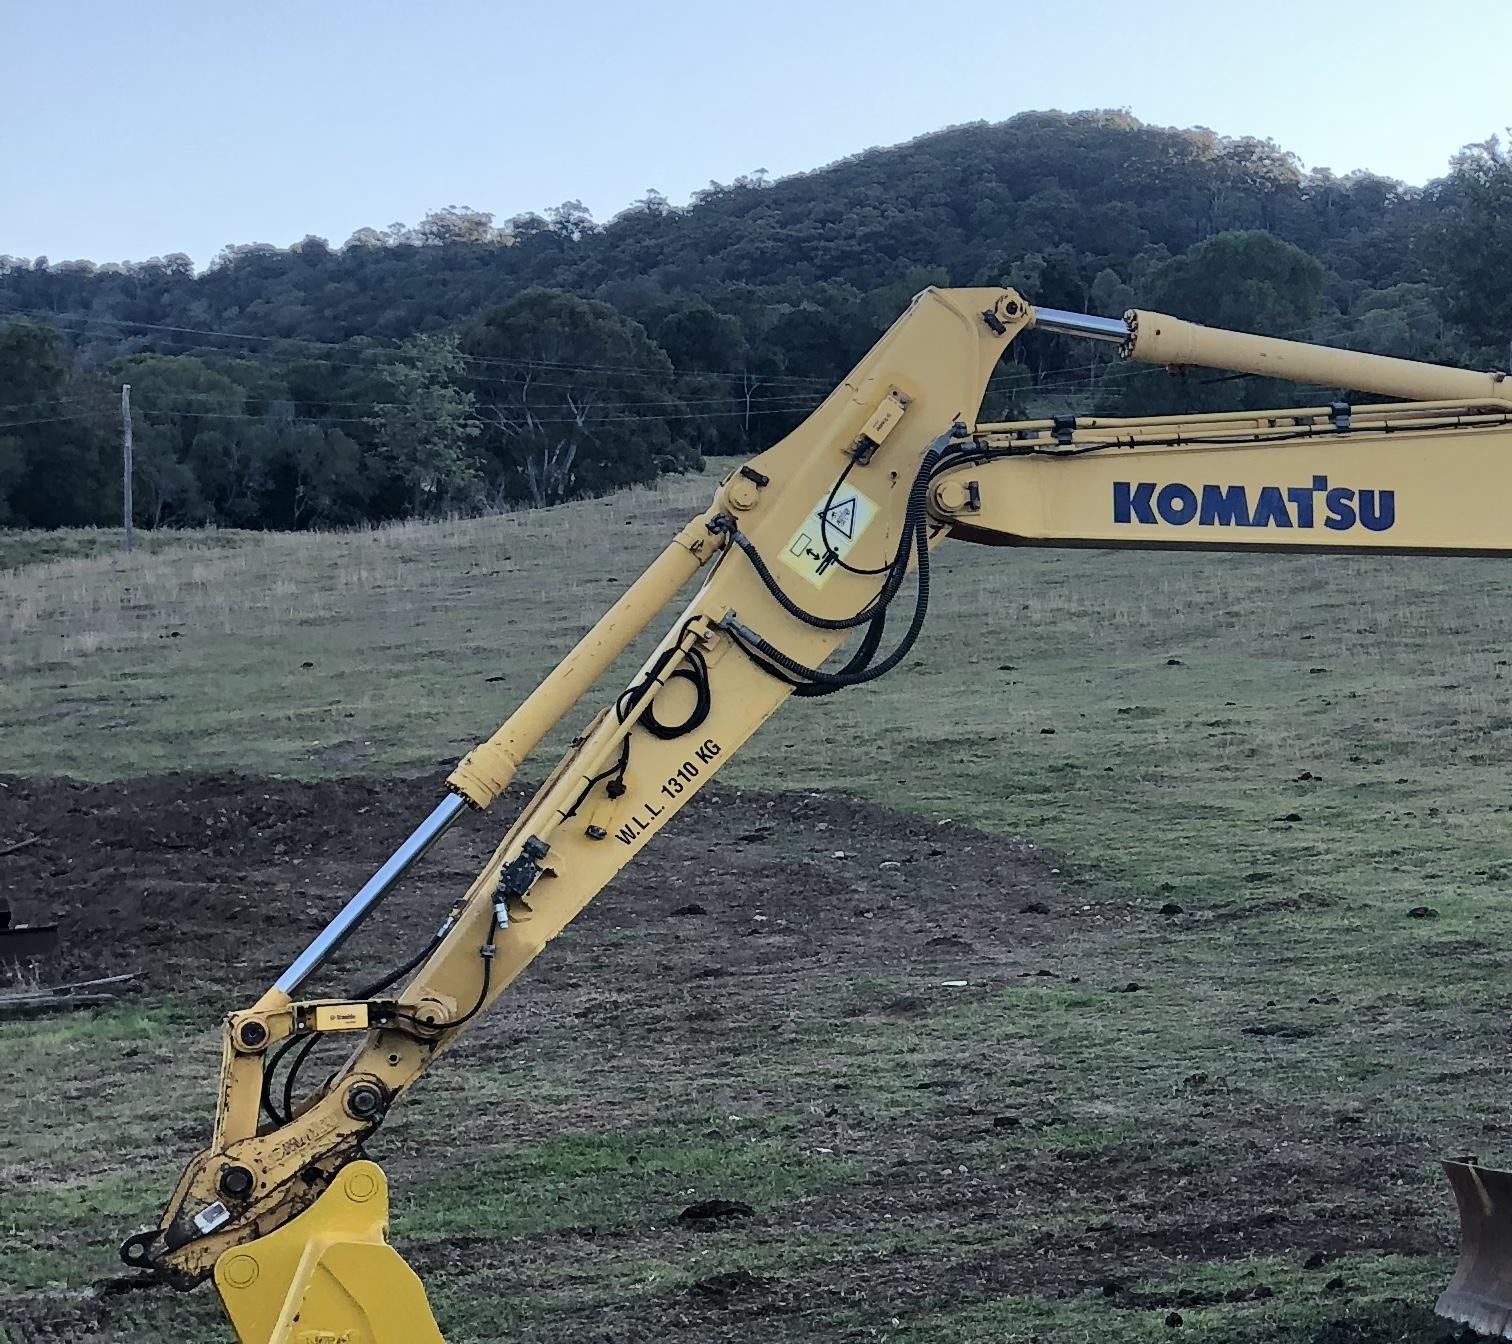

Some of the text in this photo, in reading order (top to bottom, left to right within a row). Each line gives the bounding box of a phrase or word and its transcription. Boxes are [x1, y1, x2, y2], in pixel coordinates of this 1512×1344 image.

[1113, 475, 1395, 531] KOMATSU
[661, 761, 699, 799] 1310
[695, 739, 722, 765] KG
